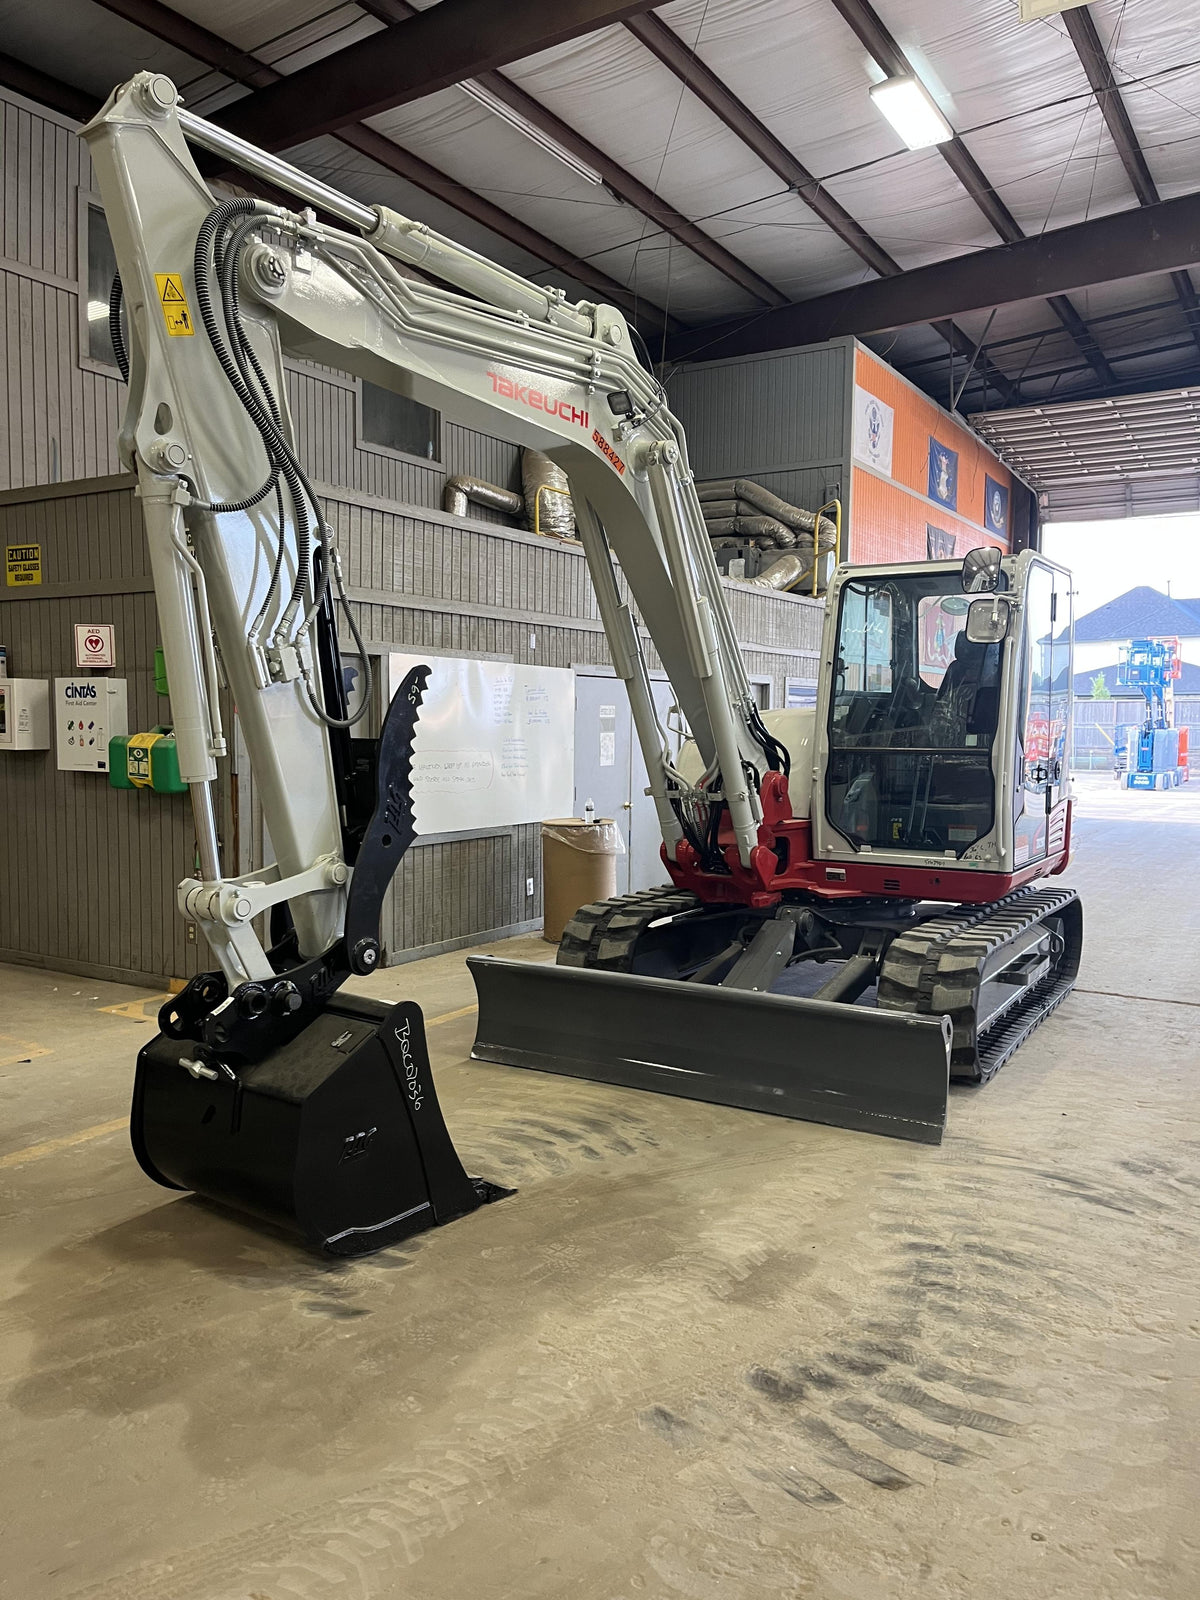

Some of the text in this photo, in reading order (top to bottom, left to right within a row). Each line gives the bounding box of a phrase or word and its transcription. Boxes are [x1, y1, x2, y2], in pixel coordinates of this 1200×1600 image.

[593, 429, 625, 473] 588427
[8, 549, 39, 560] CAUTION
[8, 564, 22, 572] SAFETY
